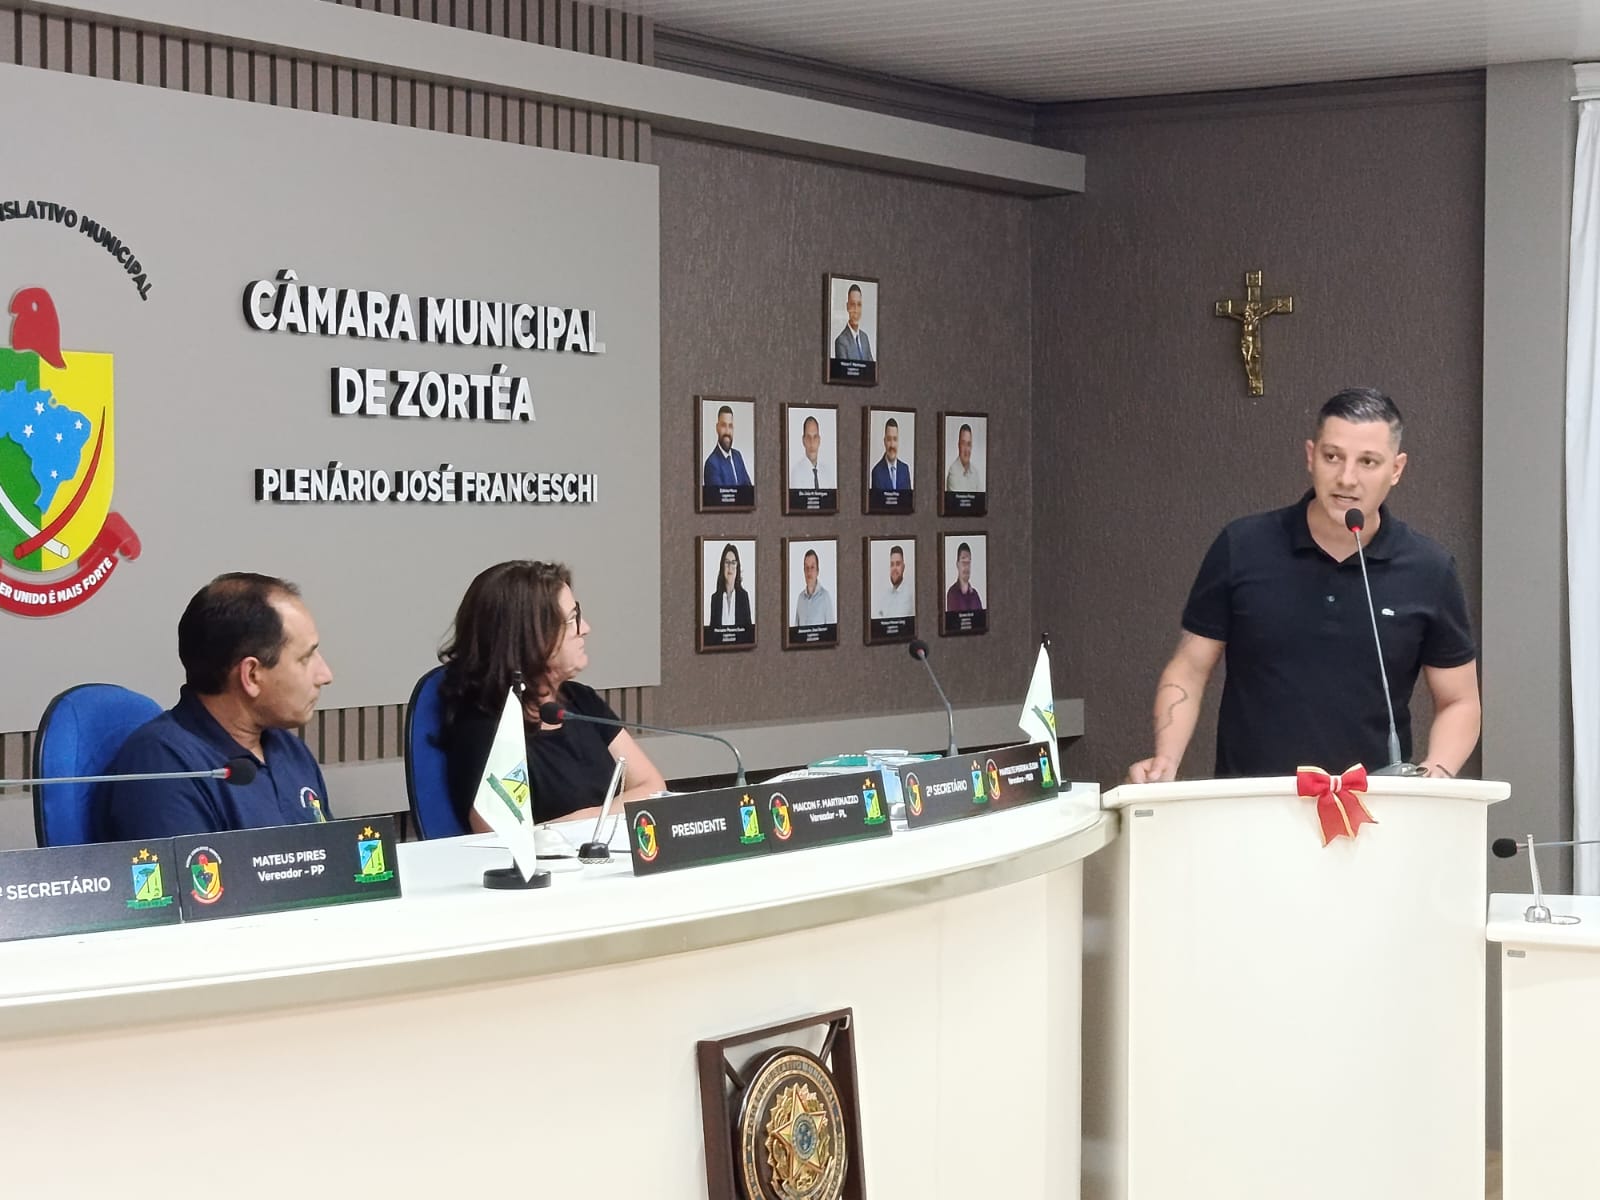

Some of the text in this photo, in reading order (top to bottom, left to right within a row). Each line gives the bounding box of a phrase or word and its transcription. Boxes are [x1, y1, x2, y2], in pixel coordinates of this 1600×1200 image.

[79, 215, 153, 301] MUNICIPAL
[243, 269, 606, 354] CÂMARA MUNICIPAL
[331, 363, 536, 422] DE ZORTÉA
[255, 460, 598, 504] PLENÁRIO JOSÉ FRANCESCHI
[13, 589, 47, 605] UNIDO
[48, 589, 57, 604] É
[57, 583, 83, 602] MAIS
[82, 556, 113, 590] FORTE
[671, 817, 728, 838] PRESIDENTE
[252, 849, 327, 868] MATEUS PIRES
[257, 867, 303, 882] Vereador
[310, 864, 325, 876] PP
[6, 875, 111, 900] SECRETÁRIO
